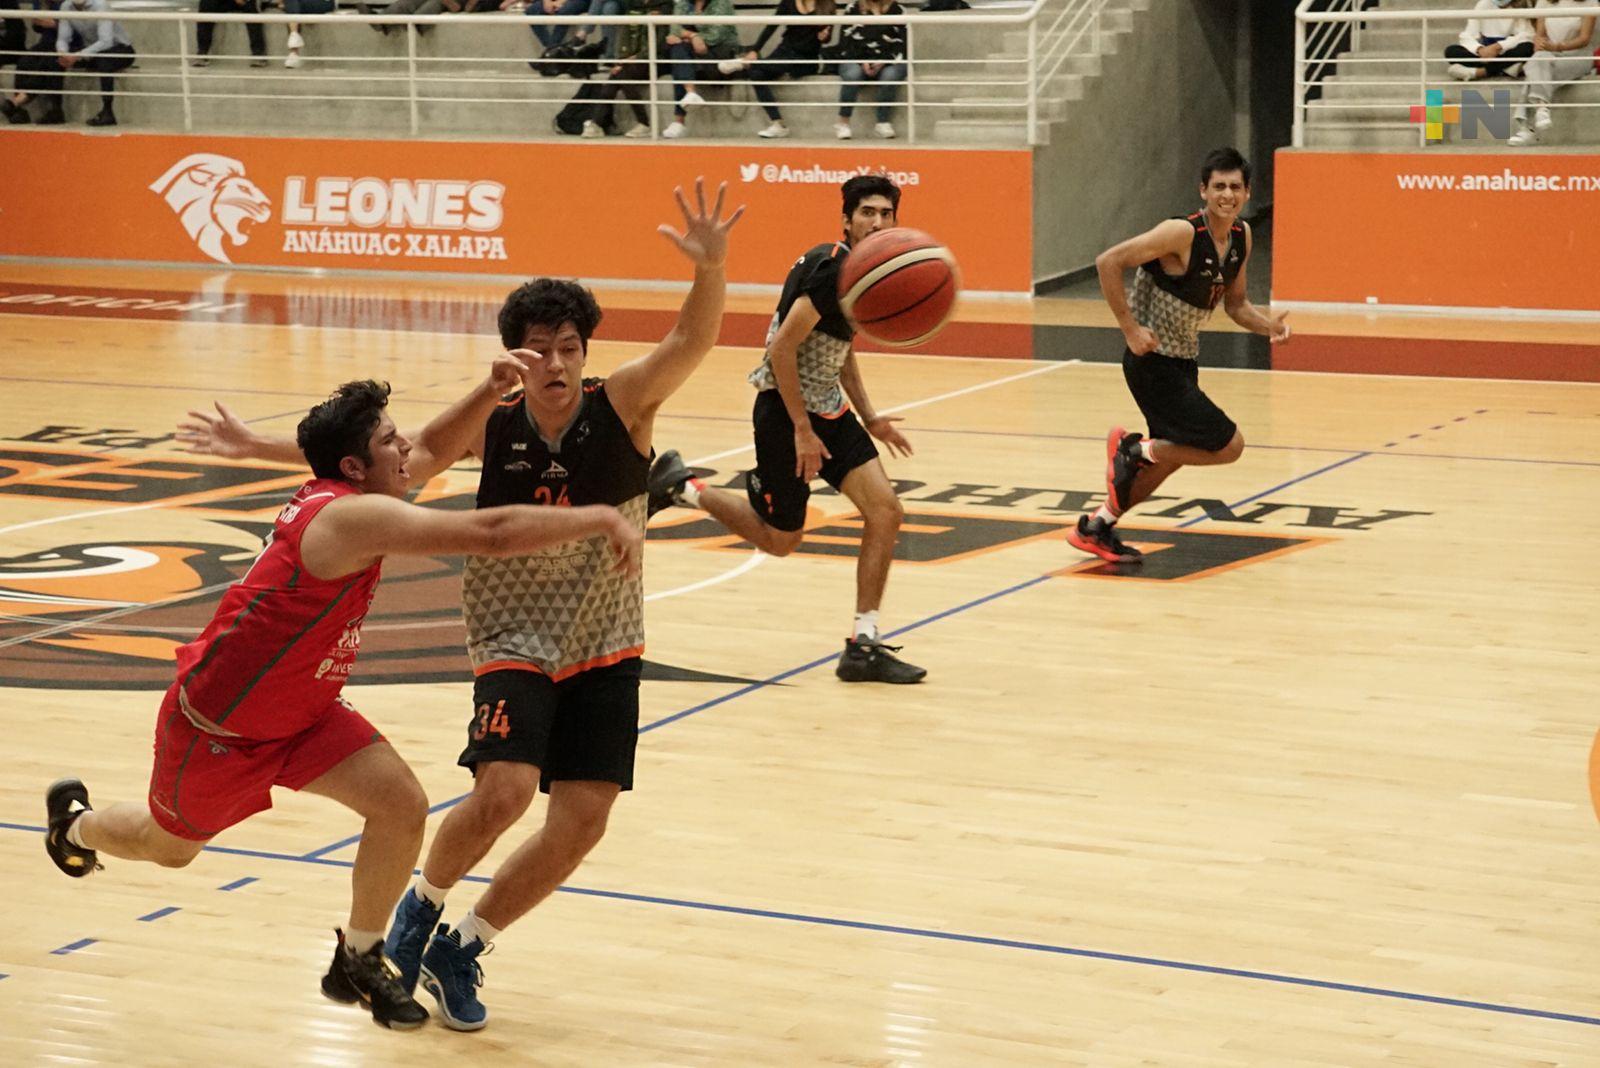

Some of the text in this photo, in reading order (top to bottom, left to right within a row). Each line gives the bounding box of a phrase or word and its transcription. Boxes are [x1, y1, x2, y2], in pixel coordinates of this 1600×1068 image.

[1397, 168, 1600, 191] www.anahuac.mx
[281, 176, 507, 231] LEONES
[282, 226, 508, 260] ANÁHUAC XALAPA
[474, 699, 510, 740] 34
